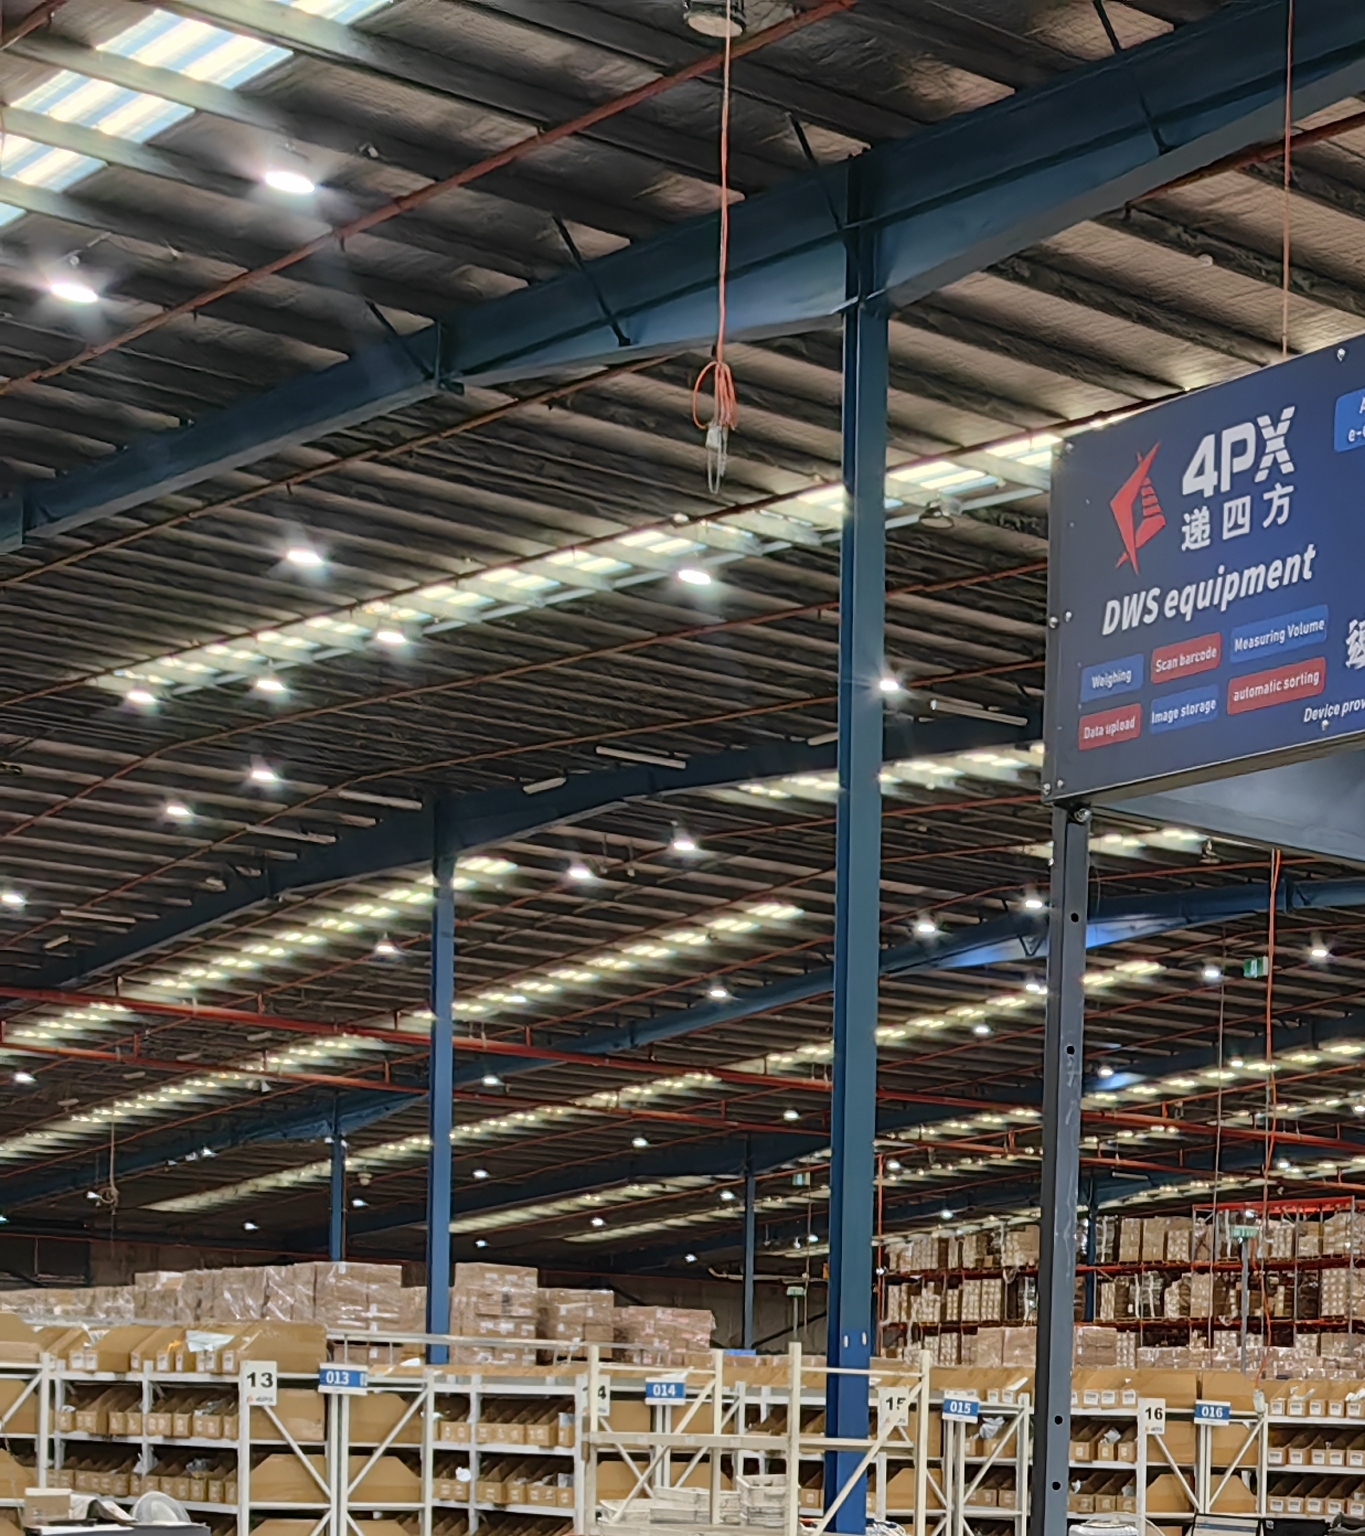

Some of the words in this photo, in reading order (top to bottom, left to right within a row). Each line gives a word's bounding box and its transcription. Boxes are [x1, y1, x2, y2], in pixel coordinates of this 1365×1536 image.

[1182, 406, 1295, 498] 4PX
[1181, 482, 1294, 552] 递四方
[1102, 587, 1160, 636] DWS
[1164, 543, 1317, 621] equipment
[1234, 627, 1286, 651] Measuring
[1287, 618, 1325, 639] Volume
[1155, 655, 1178, 673] Scan
[1179, 645, 1217, 666] barcode
[1092, 668, 1132, 690] Weighing
[1233, 679, 1282, 702] automatic
[1283, 670, 1320, 692] sorting
[1152, 706, 1180, 725] Image
[1181, 698, 1217, 719] storage
[1304, 700, 1340, 724] Device
[1083, 724, 1104, 740] Data
[1105, 716, 1136, 737] upload
[247, 1372, 273, 1388] 13
[326, 1371, 350, 1385] 013
[652, 1384, 676, 1397] 014
[950, 1401, 972, 1414] 015
[1145, 1407, 1163, 1420] 16
[1201, 1406, 1224, 1418] 016
